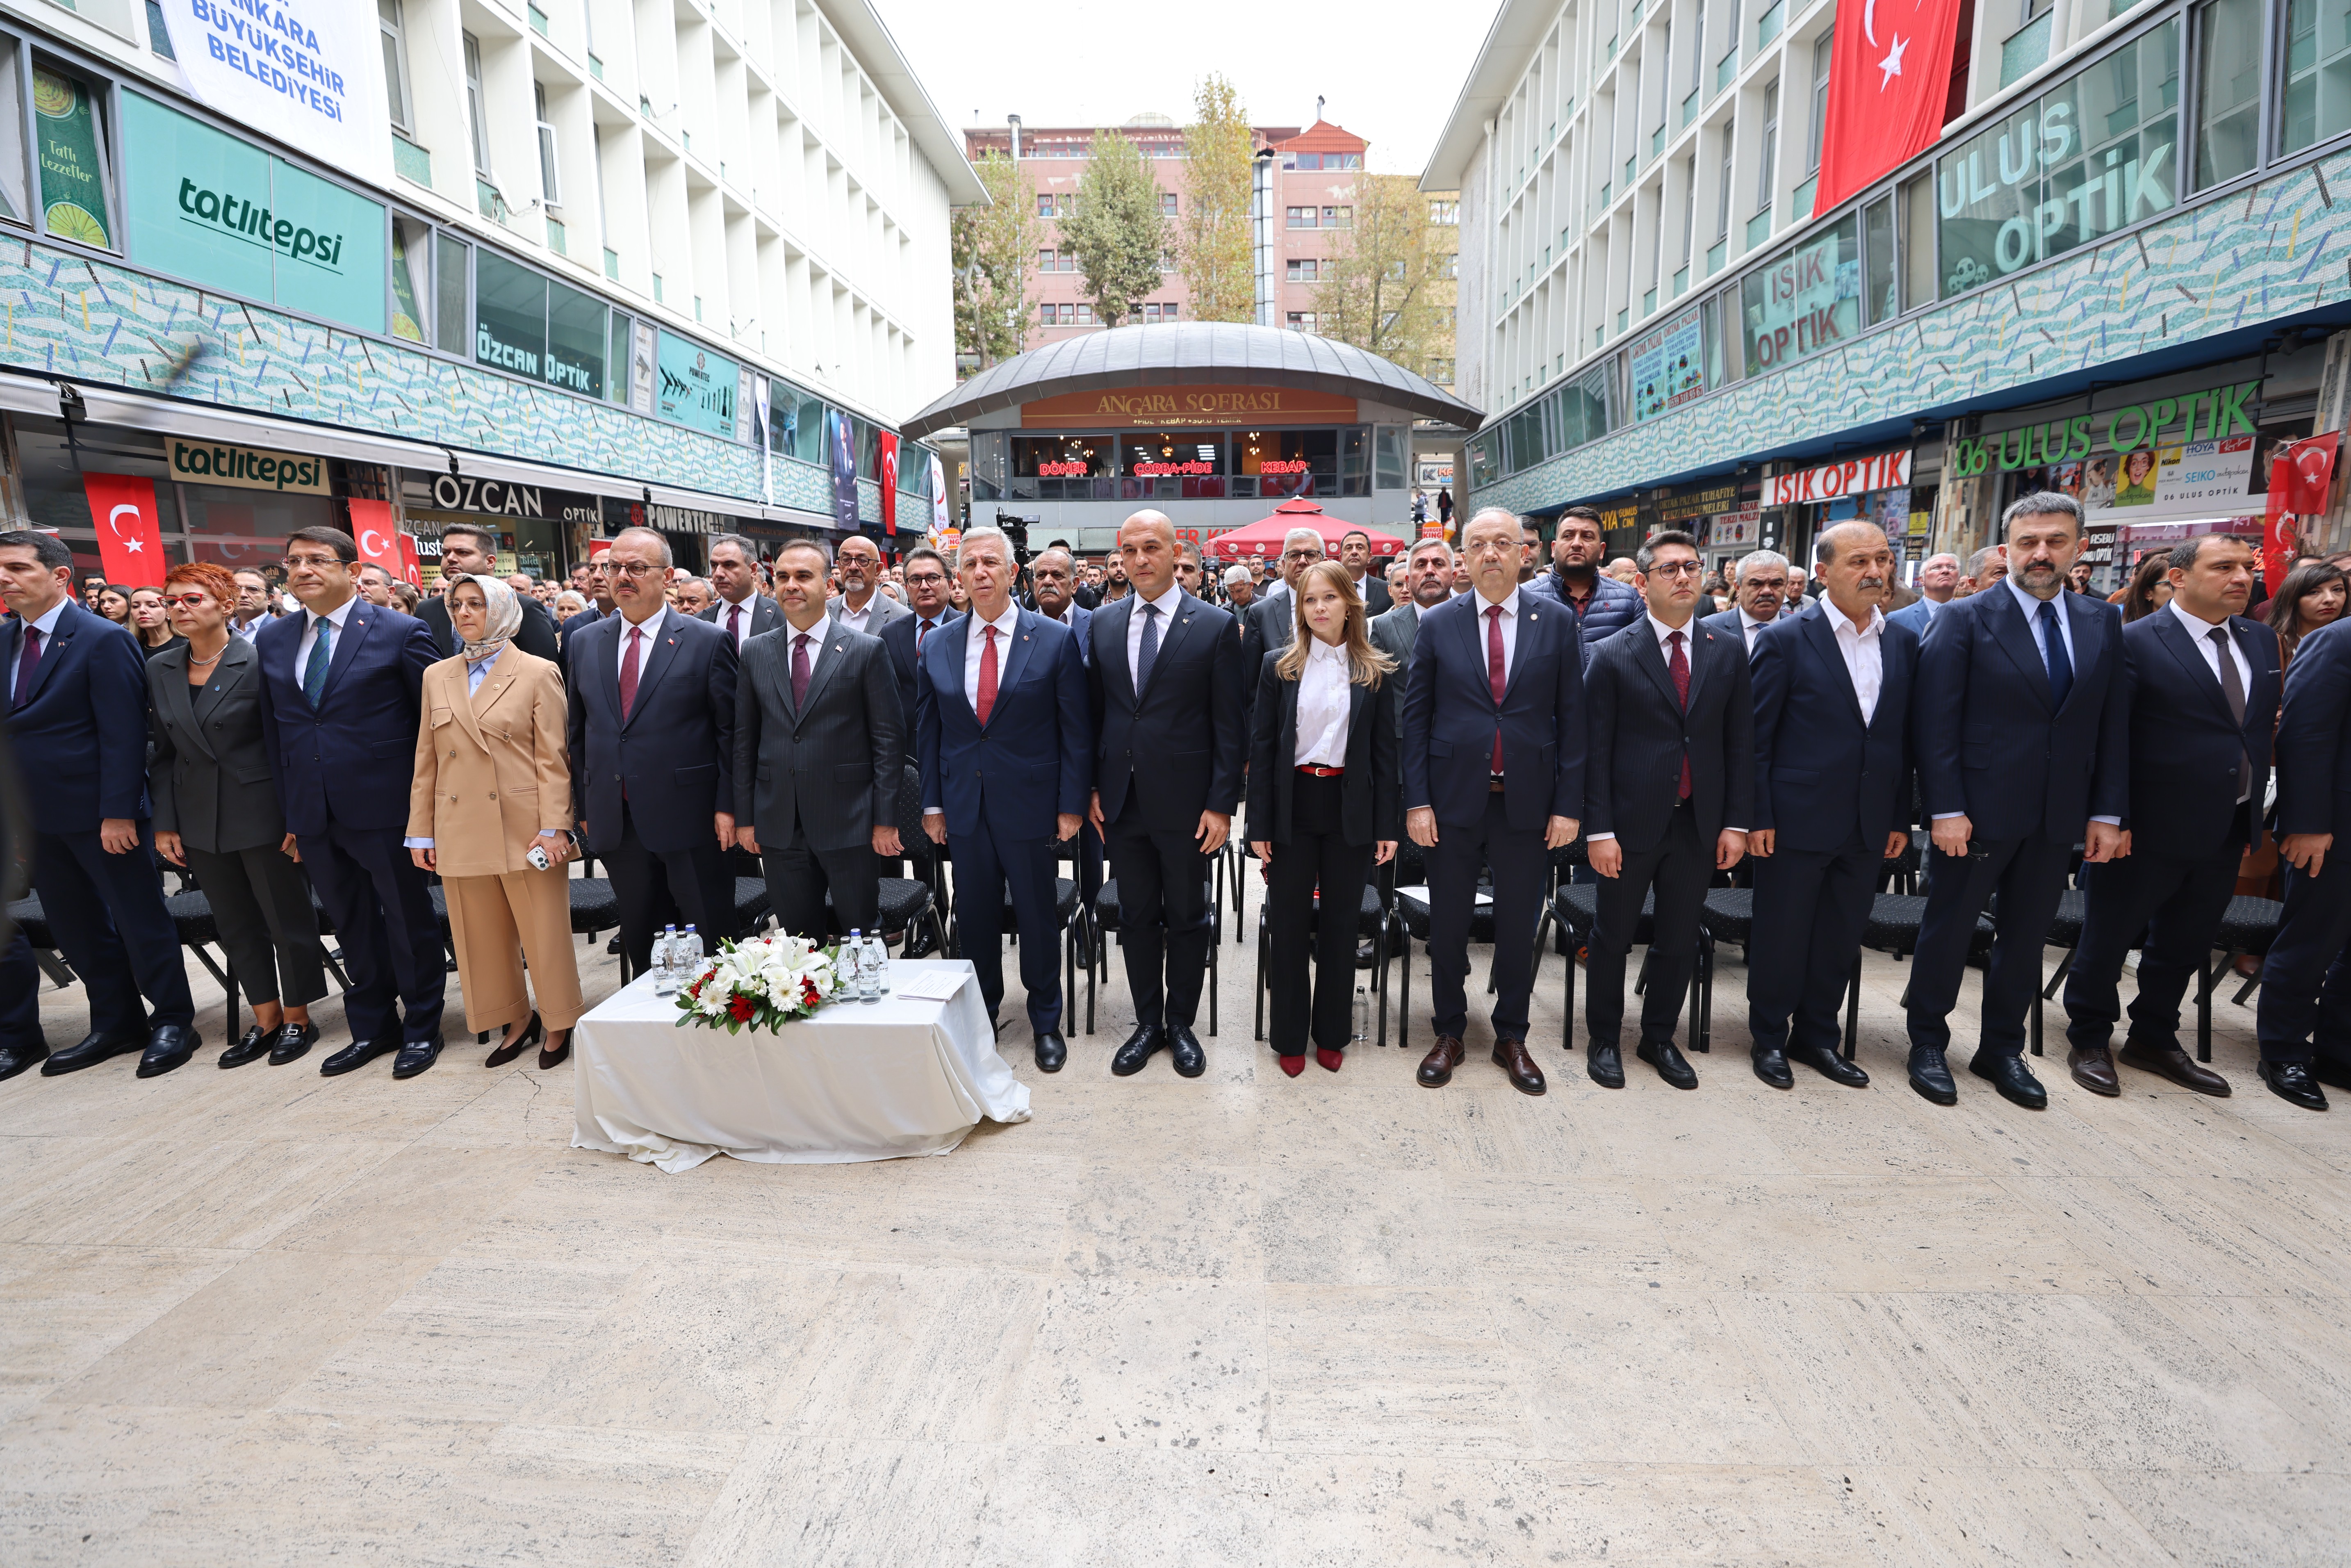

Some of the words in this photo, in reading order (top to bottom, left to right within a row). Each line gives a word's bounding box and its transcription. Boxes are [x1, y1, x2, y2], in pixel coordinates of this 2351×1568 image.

[230, 0, 321, 55] NKARA
[207, 32, 342, 123] BELEDİYESİ
[48, 139, 76, 162] Tatlı
[1940, 102, 2070, 219] ULUS
[41, 153, 92, 182] Lezzetler
[1995, 142, 2173, 273] OPTİK
[179, 177, 343, 265] tatlıtepsi
[1772, 247, 1825, 309] IŞIK
[1664, 321, 1680, 338] ORTAK
[1681, 309, 1699, 325] PAZAR
[1757, 301, 1839, 367] OPTİK
[477, 322, 537, 375] ÖZCAN
[1633, 342, 1647, 360] ORTAK
[1648, 331, 1663, 352] PAZAR
[1665, 335, 1676, 346] TERZİ
[1667, 338, 1685, 352] TUHAFİYE
[1686, 331, 1697, 343] DİKİŞ
[1669, 339, 1696, 358] MALZEMELERİ
[544, 353, 590, 391] OPTİK
[689, 366, 710, 383] POWERTEC
[1638, 368, 1661, 386] MALZEMELERİ
[1096, 394, 1179, 416] ANGARA
[1186, 392, 1281, 411] SOFRASI
[1668, 397, 1679, 408] 0539
[1690, 391, 1696, 401] 93
[1697, 387, 1703, 397] 67
[1957, 435, 1988, 476] 06
[2000, 415, 2094, 470] ULUS
[2108, 380, 2262, 452] OPTİK
[2186, 442, 2215, 454] HOYA
[2221, 438, 2250, 451] Ray-Ban
[174, 442, 320, 490] tatlıtepsi
[1261, 460, 1306, 474] KEBAP
[1822, 449, 1907, 497] OPTİK
[2161, 458, 2180, 466] Nikon
[2185, 469, 2215, 483] SEIKO
[1660, 497, 1679, 510] ORTAK
[1680, 493, 1700, 506] PAZAR
[1701, 486, 1736, 501] TUHAFİYE
[2208, 487, 2239, 497] OPTİK
[563, 506, 598, 523] OPTİK
[646, 504, 714, 533] POWERTEC
[1663, 509, 1680, 520] TERZİ
[1681, 500, 1729, 517] MALZEMELERİ
[1720, 514, 1738, 525] TERZİ
[2089, 533, 2115, 545] ASBÜ
[2095, 545, 2113, 562] OPTİK
